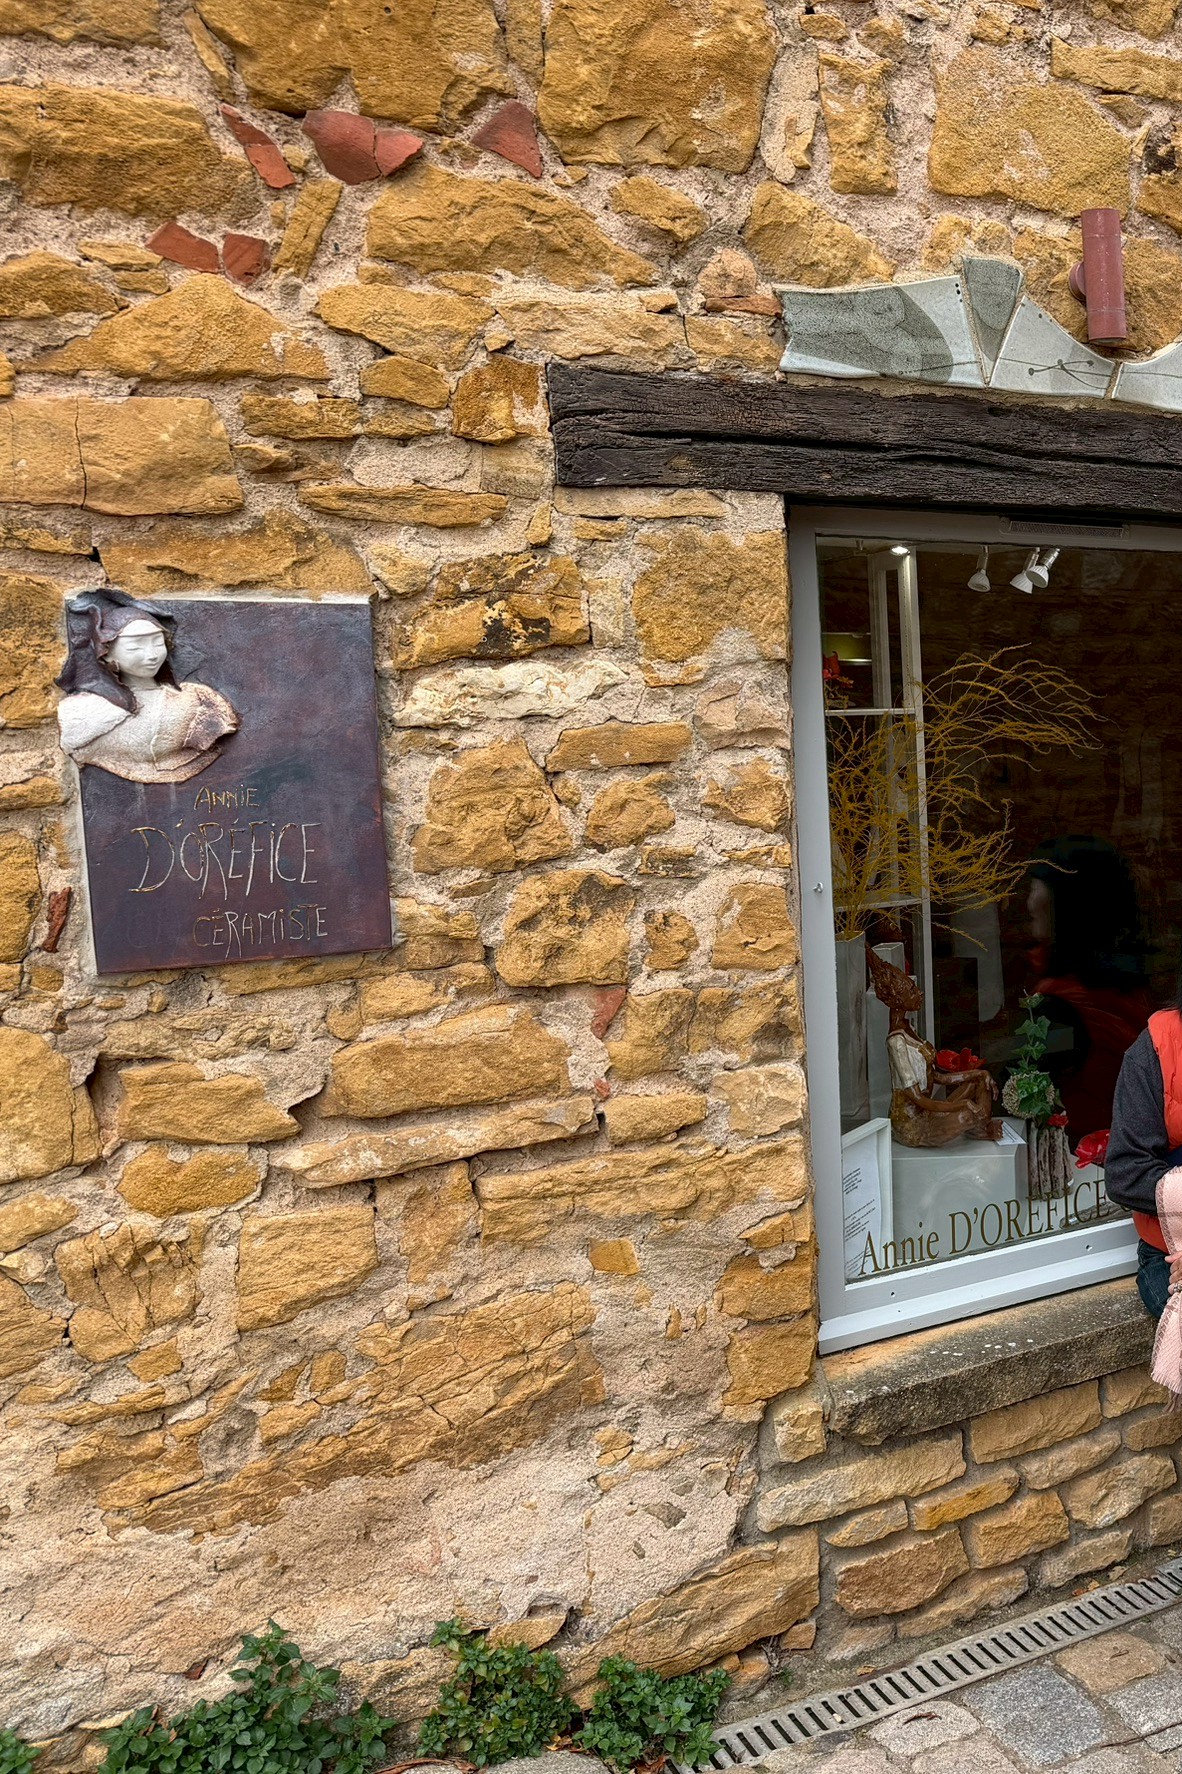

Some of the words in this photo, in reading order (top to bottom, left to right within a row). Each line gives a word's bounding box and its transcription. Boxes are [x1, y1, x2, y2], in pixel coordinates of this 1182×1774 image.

[194, 784, 260, 814] ANNIE
[857, 1221, 940, 1276] Annie
[948, 1179, 1111, 1255] D'OREFICE
